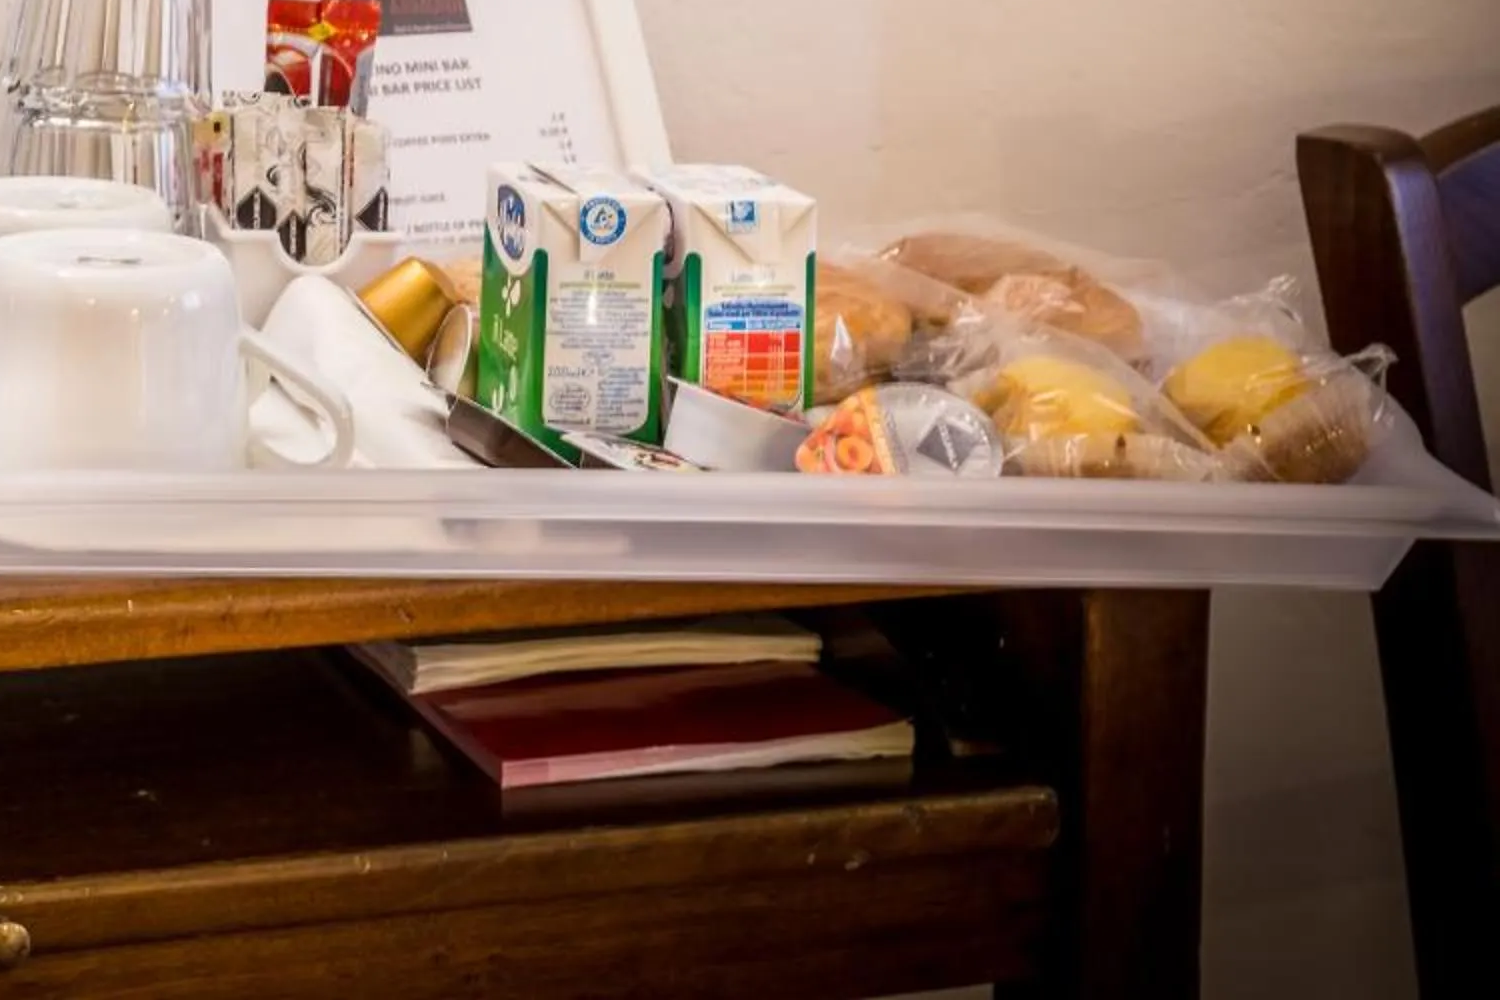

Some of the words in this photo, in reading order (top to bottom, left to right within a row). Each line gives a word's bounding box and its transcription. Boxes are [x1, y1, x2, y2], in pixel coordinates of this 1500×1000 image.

[404, 60, 439, 74] MINI
[441, 58, 470, 71] BAR
[382, 82, 410, 96] BAR
[413, 80, 451, 93] PRICE
[454, 77, 482, 90] LIST
